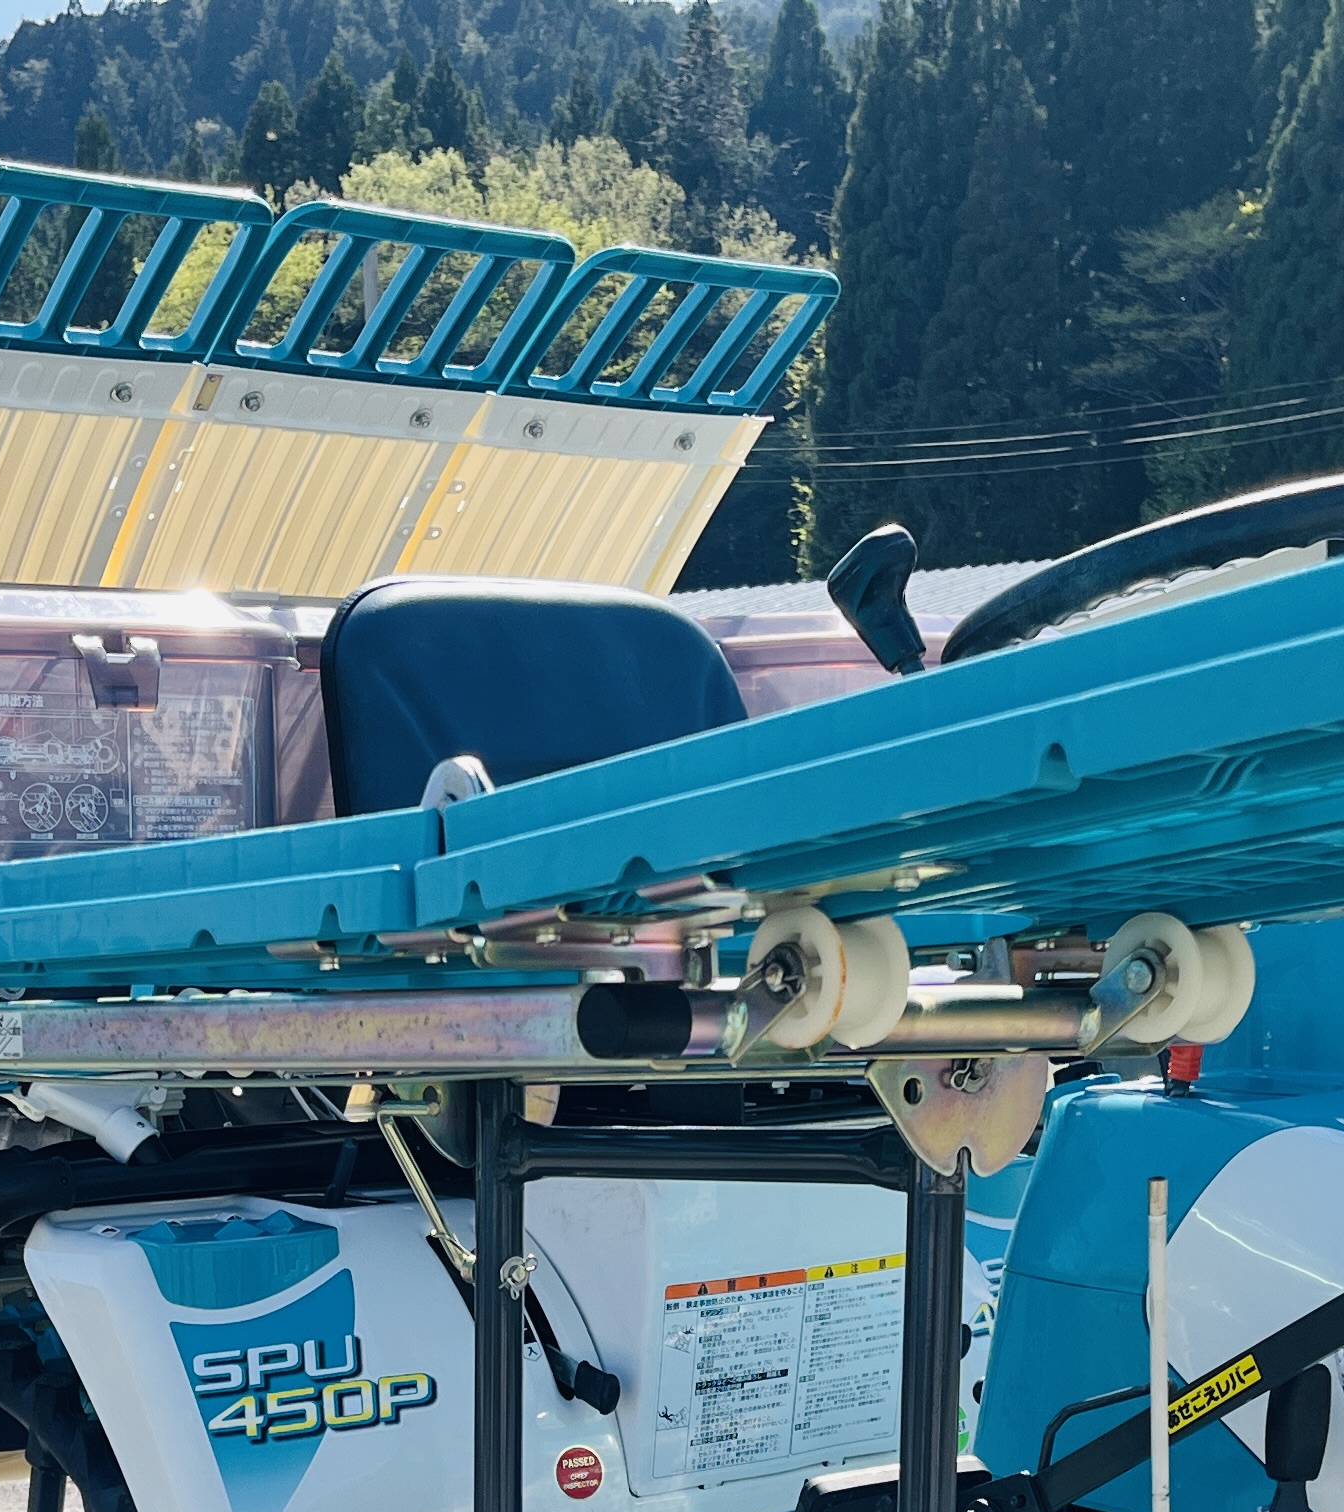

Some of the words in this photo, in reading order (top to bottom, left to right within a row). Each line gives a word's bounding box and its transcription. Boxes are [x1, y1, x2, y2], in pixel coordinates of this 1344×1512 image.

[192, 1334, 359, 1393] SPU
[207, 1372, 434, 1440] 450P
[562, 1456, 595, 1469] PASSED
[570, 1471, 590, 1481] CHIEF
[563, 1479, 599, 1491] INSPECTOR
